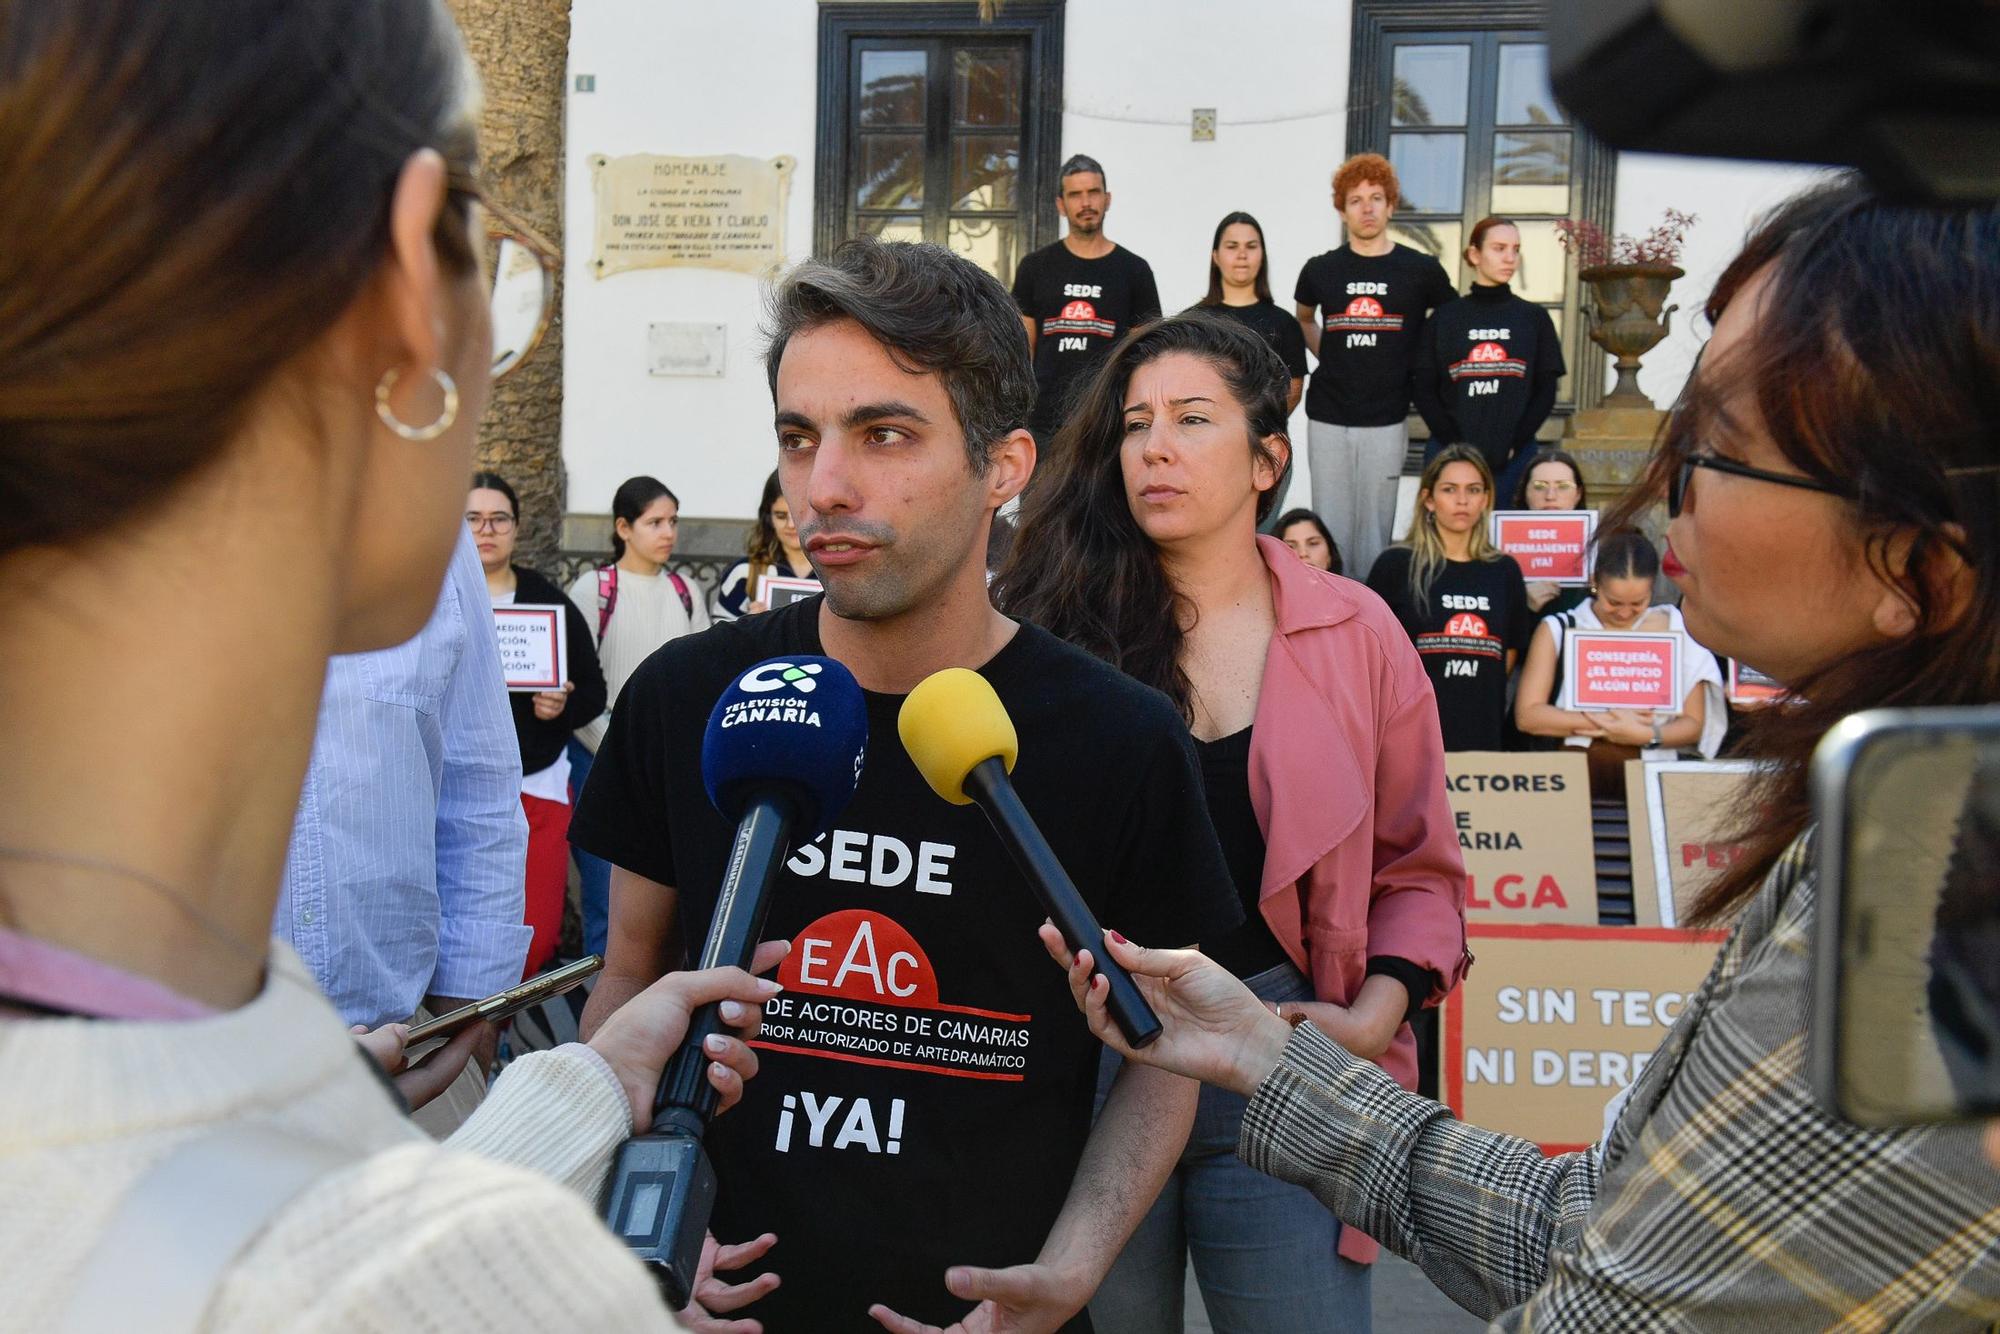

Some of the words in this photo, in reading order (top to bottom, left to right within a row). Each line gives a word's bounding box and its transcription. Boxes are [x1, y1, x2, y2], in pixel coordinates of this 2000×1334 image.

[654, 163, 727, 177] HOMENAJE
[612, 214, 632, 227] DON
[664, 214, 678, 227] DE
[682, 214, 712, 227] VIERA
[1063, 283, 1103, 299] SEDE
[1346, 282, 1389, 296] SEDE
[1346, 333, 1378, 349] ¡YA!
[1467, 328, 1511, 341] SEDE
[1058, 336, 1089, 353] ¡YA!
[1468, 379, 1500, 397] ¡YA!
[1527, 528, 1559, 541] SEDE
[1503, 542, 1580, 554] PERMANENTE
[1530, 556, 1554, 570] ¡YA!
[1441, 594, 1491, 611] SEDE
[530, 624, 547, 633] SIN
[1448, 614, 1485, 637] EAC
[499, 636, 531, 646] CIÓN,
[1443, 659, 1480, 678] ¡YA!
[1586, 665, 1607, 678] ¿EL
[1609, 665, 1663, 679] EDIFICIO
[1588, 678, 1630, 692] ALGÚN
[725, 697, 808, 714] TELEVISIÓN
[721, 707, 822, 728] CANARIA
[787, 829, 957, 896] SEDE
[800, 920, 919, 998] EAC
[1497, 986, 1577, 1025] SIN
[1592, 989, 1696, 1027] TEC
[765, 998, 795, 1018] DE
[798, 1001, 898, 1032] ACTORES
[904, 1015, 933, 1037] DE
[937, 1019, 1031, 1048] CANARIAS
[760, 1022, 795, 1041] RIOR
[797, 1028, 890, 1053] AUTORIZADO
[892, 1041, 913, 1057] DE
[1466, 1048, 1516, 1085] NI
[775, 1091, 906, 1155] ¡YA!
